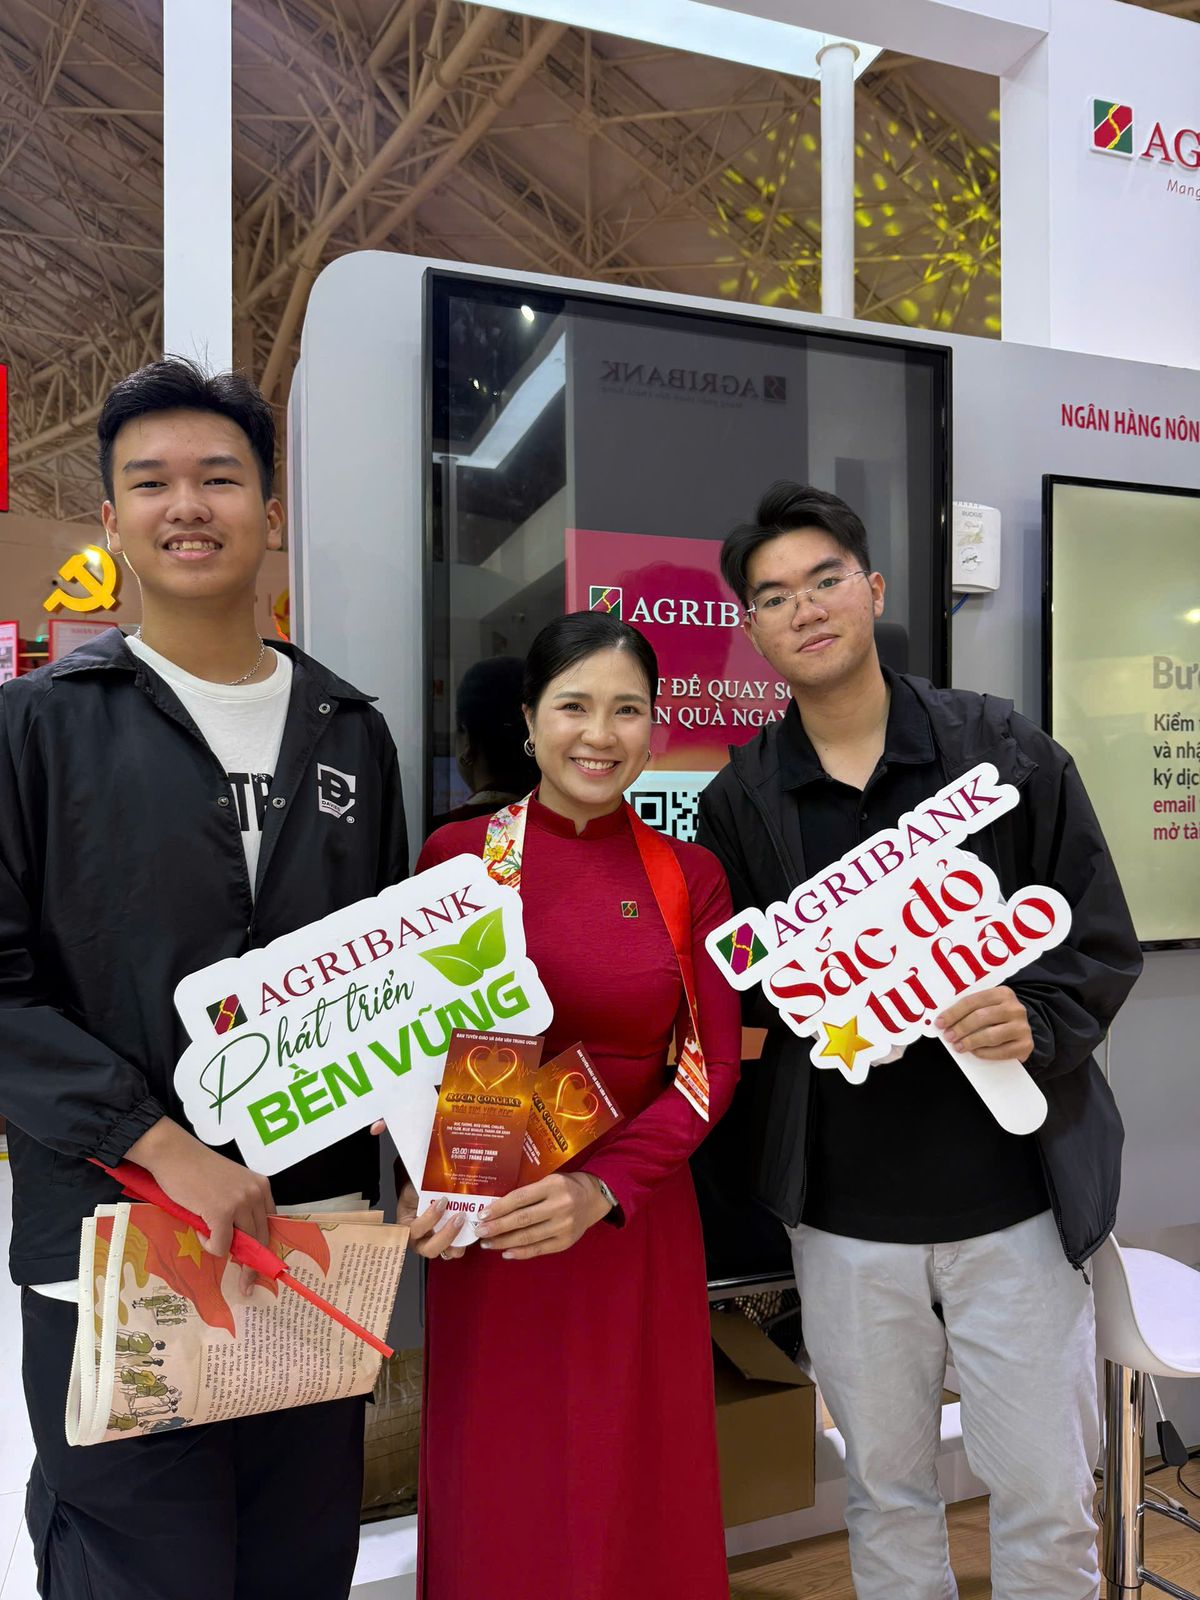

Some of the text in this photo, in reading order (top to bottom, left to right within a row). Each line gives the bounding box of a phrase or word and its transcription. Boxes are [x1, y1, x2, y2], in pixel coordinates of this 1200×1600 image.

[1141, 122, 1200, 168] AG
[1061, 403, 1200, 443] NGÂN HÀNG NÔN
[628, 596, 746, 628] AGRIB
[671, 673, 702, 697] ĐỂ
[707, 679, 769, 701] QUAY
[1153, 656, 1200, 690] Bư
[652, 706, 672, 724] N
[677, 703, 727, 729] QUÀ
[1154, 712, 1194, 732] Kiểm
[1153, 741, 1171, 758] và
[1153, 768, 1173, 789] ký
[1153, 795, 1195, 813] email
[1153, 821, 1180, 840] mở
[766, 775, 1003, 948] AGRIBANK
[258, 884, 487, 1016] AGRIBANK
[769, 858, 983, 1025] Sắc đỏ
[865, 897, 1056, 1034] tự hào
[199, 969, 415, 1125] Phát triển
[246, 970, 531, 1147] BỀN VỮNG
[445, 1093, 521, 1107] ROCK CONCERT
